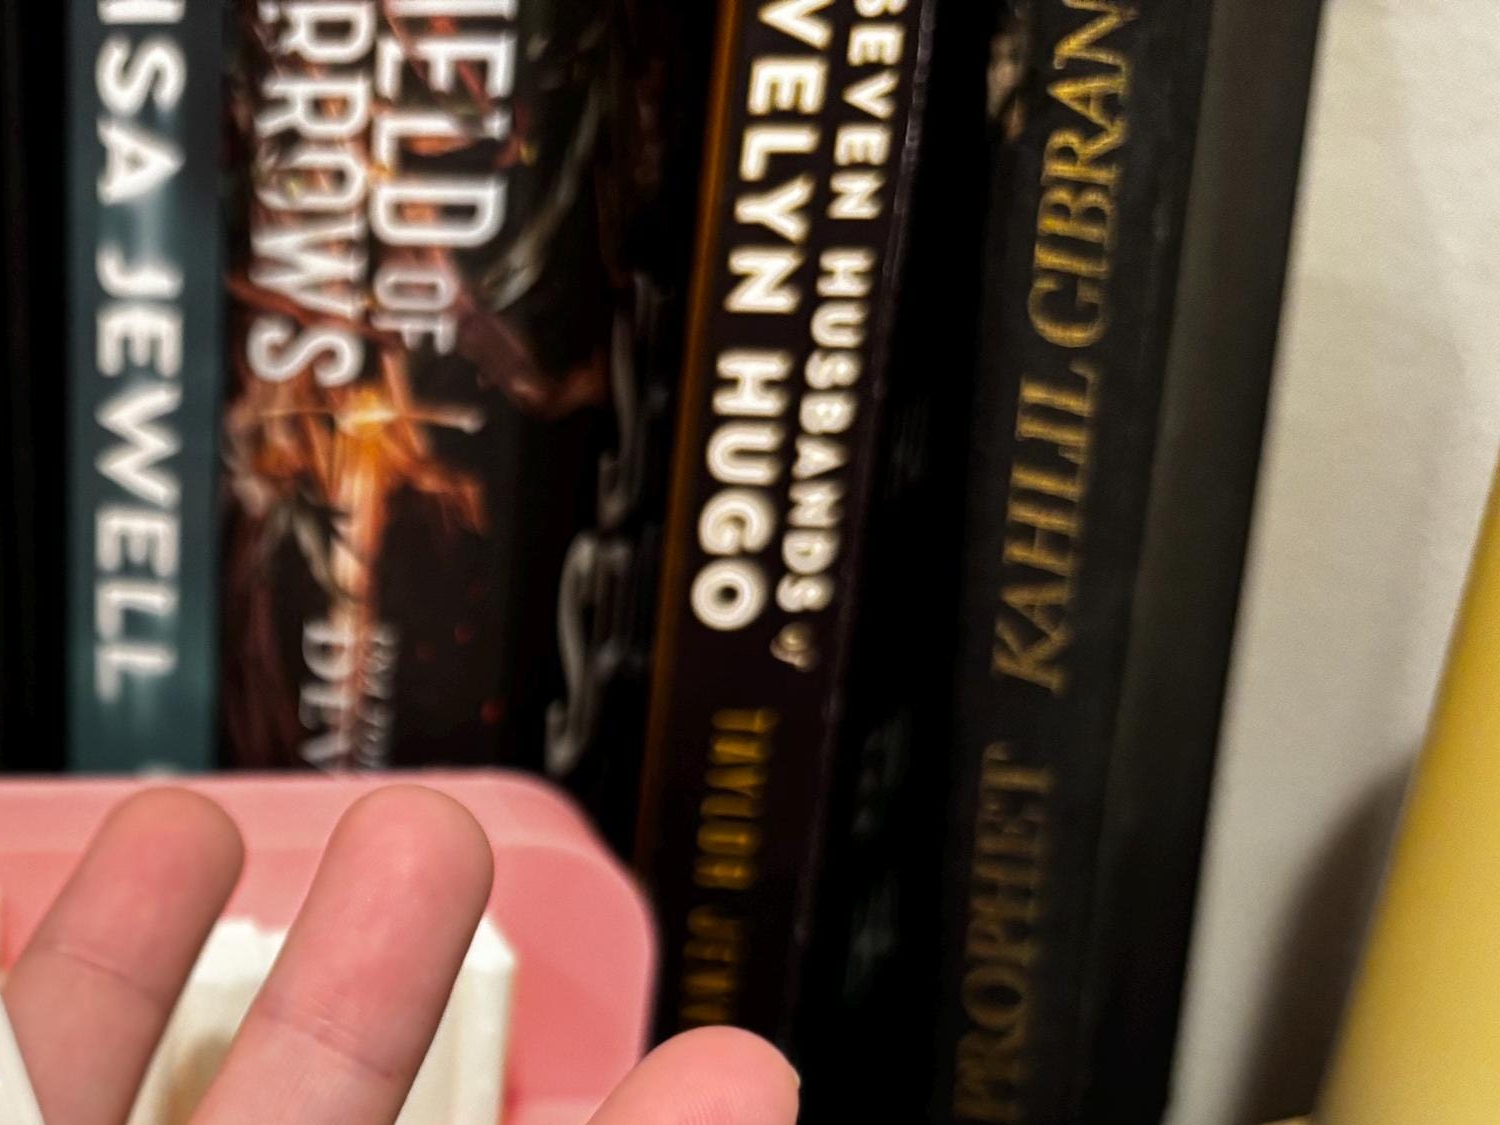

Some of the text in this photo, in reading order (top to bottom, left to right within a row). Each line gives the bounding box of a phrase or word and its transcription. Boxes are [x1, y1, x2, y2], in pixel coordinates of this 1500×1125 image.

[246, 0, 376, 388] RROWS
[374, 266, 460, 355] OF
[991, 0, 1140, 694] KAHLIL GIBRAN
[93, 246, 184, 703] JEWELL
[690, 348, 792, 631] HUGO
[777, 247, 876, 612] HUSBANDS
